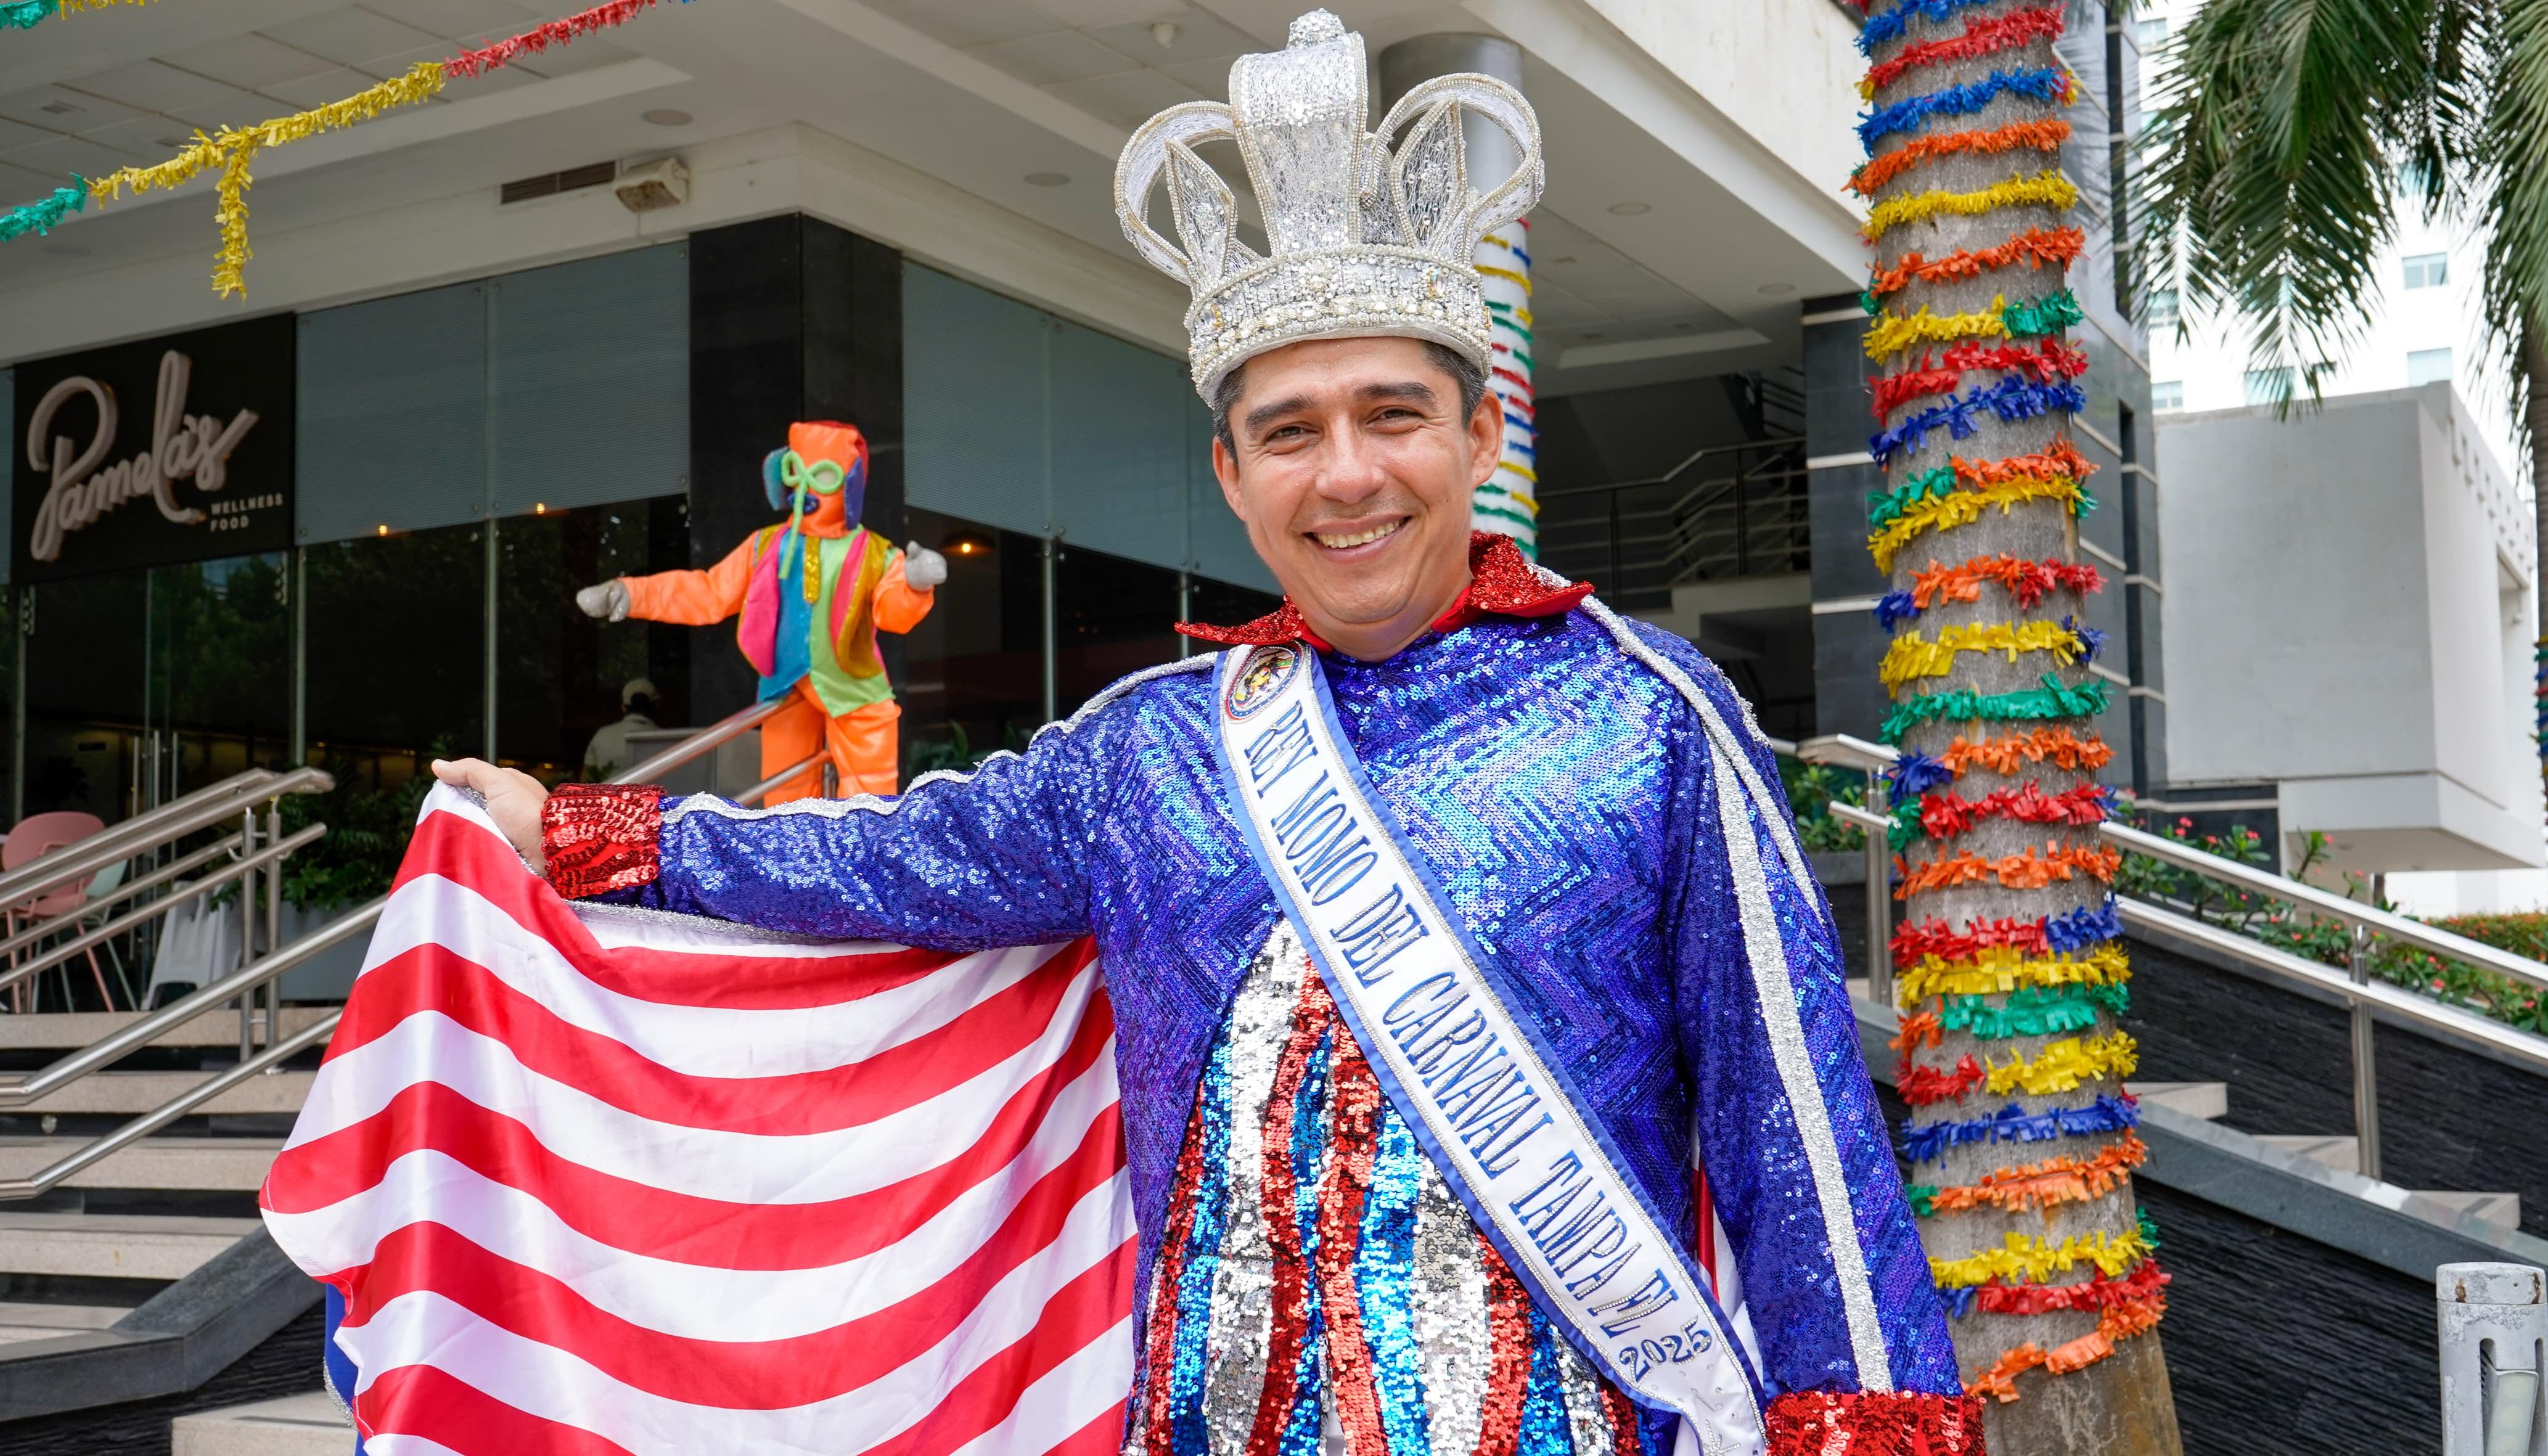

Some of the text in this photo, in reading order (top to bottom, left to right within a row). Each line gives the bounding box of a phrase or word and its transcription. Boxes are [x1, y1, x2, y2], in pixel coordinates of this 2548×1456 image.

[210, 515, 249, 532] FOOD
[211, 493, 283, 515] WELLNESS
[1244, 699, 1679, 1338] REY MOMO DEL CARNAVAL TAMPA FL
[1619, 1315, 1713, 1387] 2025
